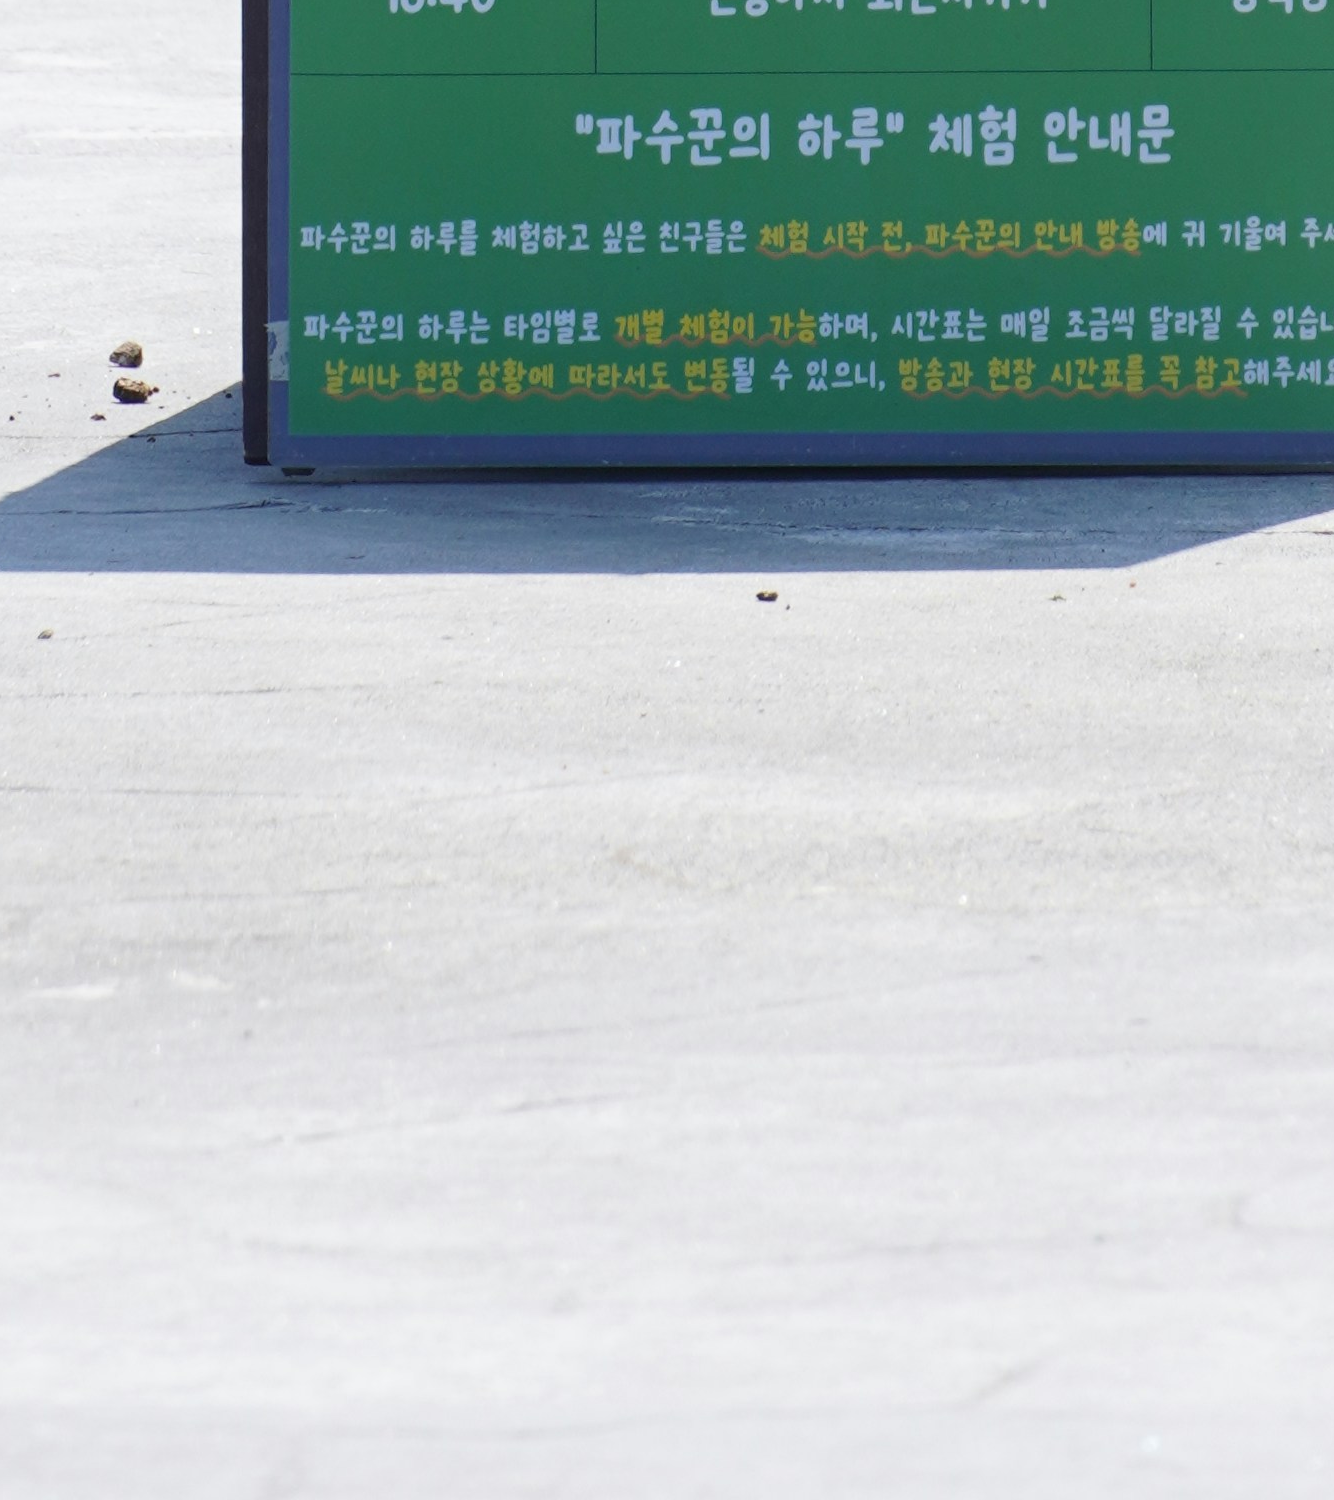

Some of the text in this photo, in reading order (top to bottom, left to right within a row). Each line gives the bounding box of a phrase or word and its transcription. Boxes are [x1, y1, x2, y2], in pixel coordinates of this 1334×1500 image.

[928, 104, 1017, 167] 체험
[1043, 104, 1175, 164] 안내문
[300, 221, 396, 255] 파수꾼의
[410, 219, 479, 257] 하루를
[491, 220, 590, 255] 체험하고
[602, 220, 647, 254] 싶은
[659, 219, 747, 255] 친구들은
[759, 219, 809, 254] 체험
[823, 219, 869, 252] 시작
[881, 219, 913, 254] 전,
[925, 218, 1021, 252] 파수꾼의
[1034, 218, 1084, 252] 안내
[1096, 218, 1168, 252] 방송에
[1181, 220, 1206, 248] 귀
[1219, 215, 1287, 252] 기울여
[303, 310, 404, 345] 파수꾼의
[418, 310, 491, 345] 하루는
[503, 308, 601, 345] 타임별로
[615, 308, 665, 345] 개별
[679, 308, 755, 345] 체험이
[769, 307, 879, 345] 가능하며,
[891, 308, 988, 343] 시간표는
[1000, 306, 1050, 343] 매일
[1065, 306, 1135, 342] 조금씩
[1149, 305, 1222, 342] 달라질
[1236, 307, 1260, 339] 수
[325, 358, 401, 395] 날씨나
[415, 359, 464, 394] 현장
[477, 357, 555, 395] 상황에
[569, 358, 671, 392] 따라서도
[685, 356, 756, 394] 변동될
[770, 358, 793, 391] 수
[805, 358, 886, 392] 있으니,
[899, 356, 973, 393] 방송과
[988, 356, 1036, 392] 현장
[1051, 353, 1146, 392] 시간표를
[1159, 355, 1181, 391] 꼭
